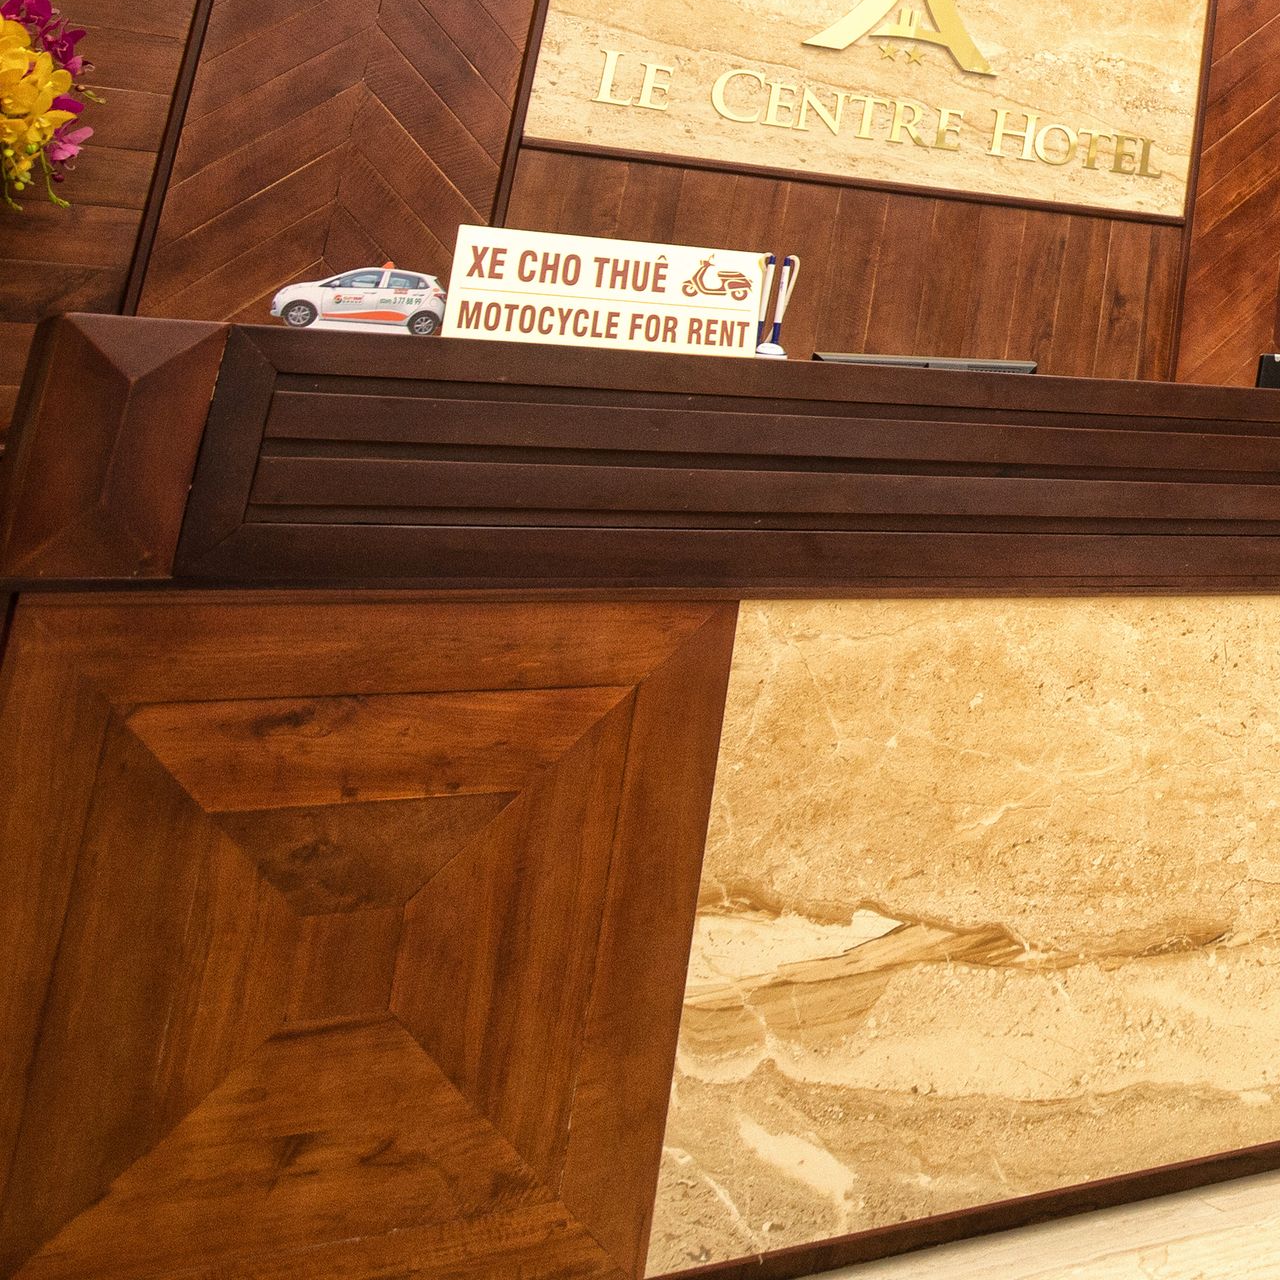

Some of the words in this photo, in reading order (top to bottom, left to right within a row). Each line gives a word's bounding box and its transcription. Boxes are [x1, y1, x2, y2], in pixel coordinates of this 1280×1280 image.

[592, 49, 676, 111] LE
[711, 69, 966, 152] CENTRE
[986, 108, 1163, 179] HOTEL
[466, 245, 508, 280] XE
[517, 250, 582, 286] CHO
[593, 255, 669, 293] THUÊ
[457, 300, 620, 340] MOTOCYCLE
[629, 313, 678, 343] FOR
[687, 318, 751, 348] RENT
